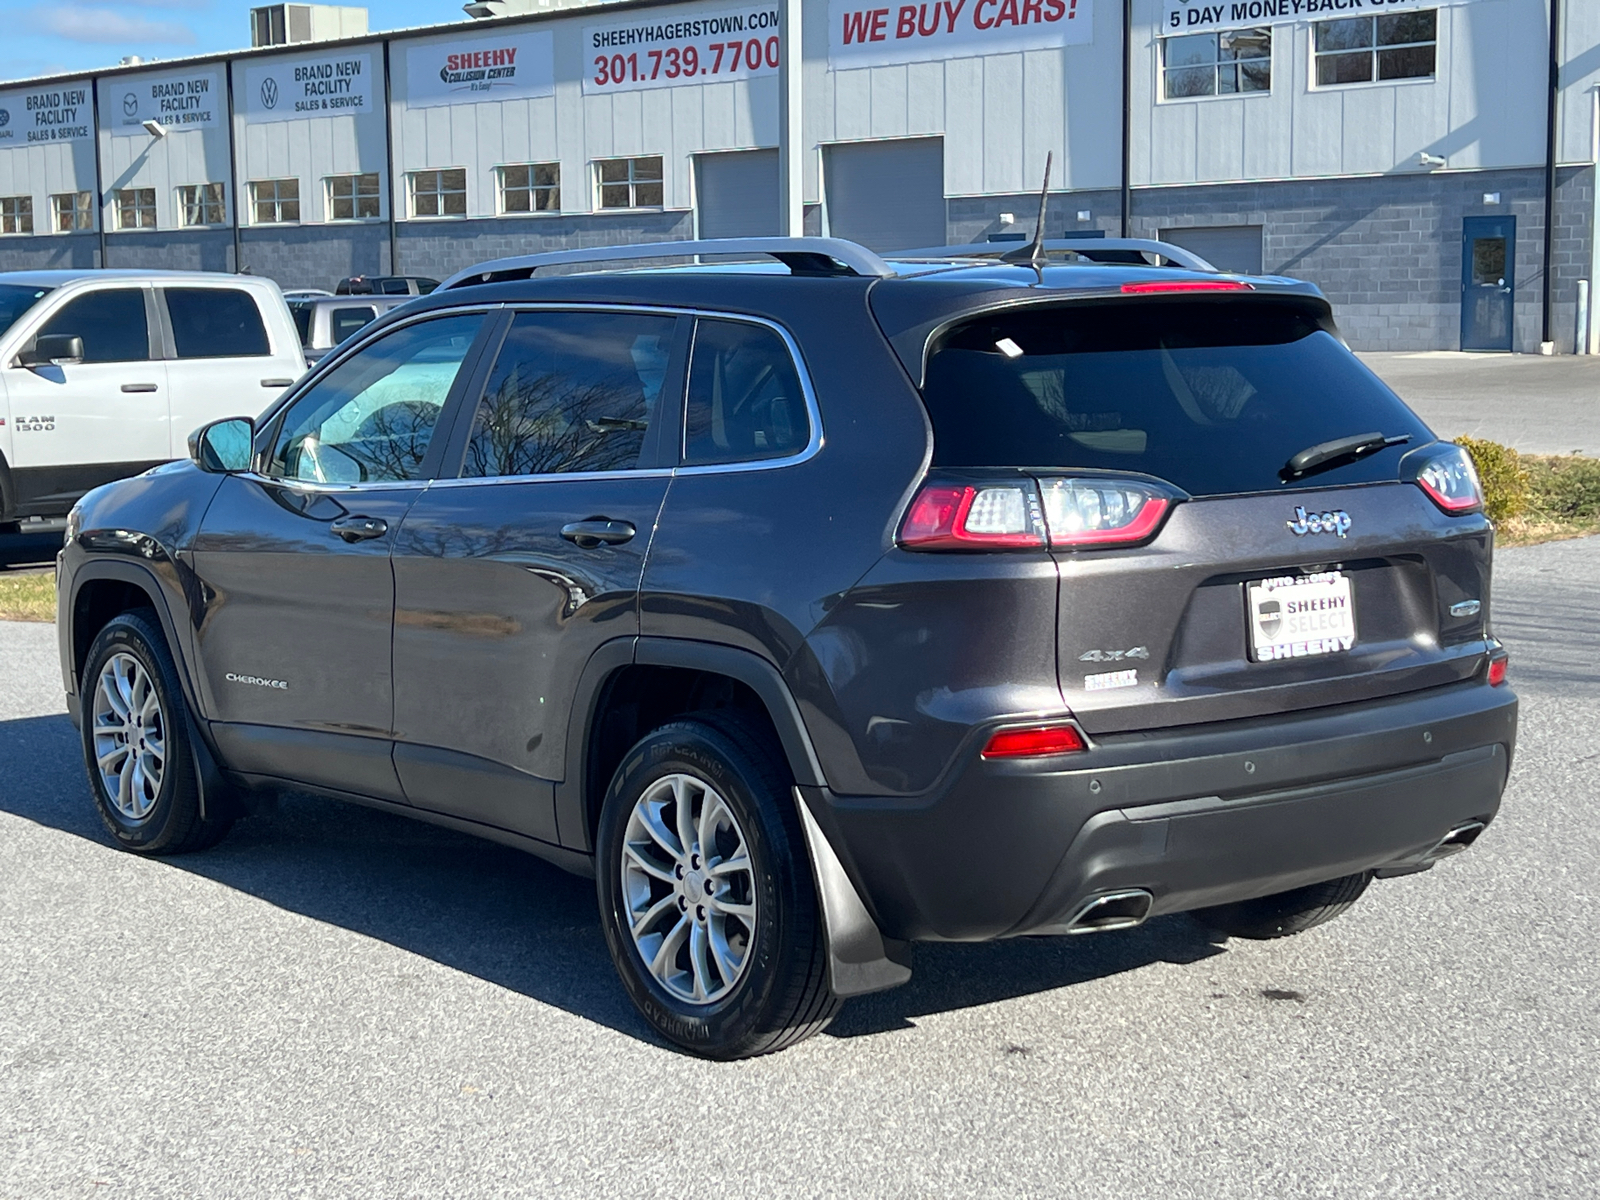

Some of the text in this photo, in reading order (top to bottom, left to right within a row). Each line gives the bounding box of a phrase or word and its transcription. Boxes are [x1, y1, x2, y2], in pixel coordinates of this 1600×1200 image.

[843, 0, 1077, 44] WE BUY CARS!
[1170, 11, 1180, 27] 5
[1187, 5, 1225, 26] DAY
[593, 10, 779, 48] SHEEHYHAGERSTOWN.COM
[447, 47, 517, 71] SHEEHY
[593, 36, 779, 86] 301.739.7700
[294, 60, 361, 82] BRAND NEW
[448, 66, 516, 84] COLLISION CENTER
[152, 79, 209, 98] BRAND NEW
[305, 78, 352, 97] FACILITY
[26, 89, 85, 111] BRAND NEW
[160, 95, 201, 113] FACILITY
[295, 95, 363, 112] SALES & SERVICE
[35, 107, 77, 126] FACILITY
[175, 114, 181, 125] &
[182, 111, 211, 123] SERVICE
[27, 125, 88, 142] SALES & SERVICE
[1286, 505, 1352, 539] Jeep
[1260, 576, 1294, 589] AUTO
[1287, 595, 1346, 614] SHEEHY
[1288, 611, 1347, 633] SELECT
[1257, 635, 1355, 662] SHEEHY
[225, 672, 288, 690] CHEROKEE
